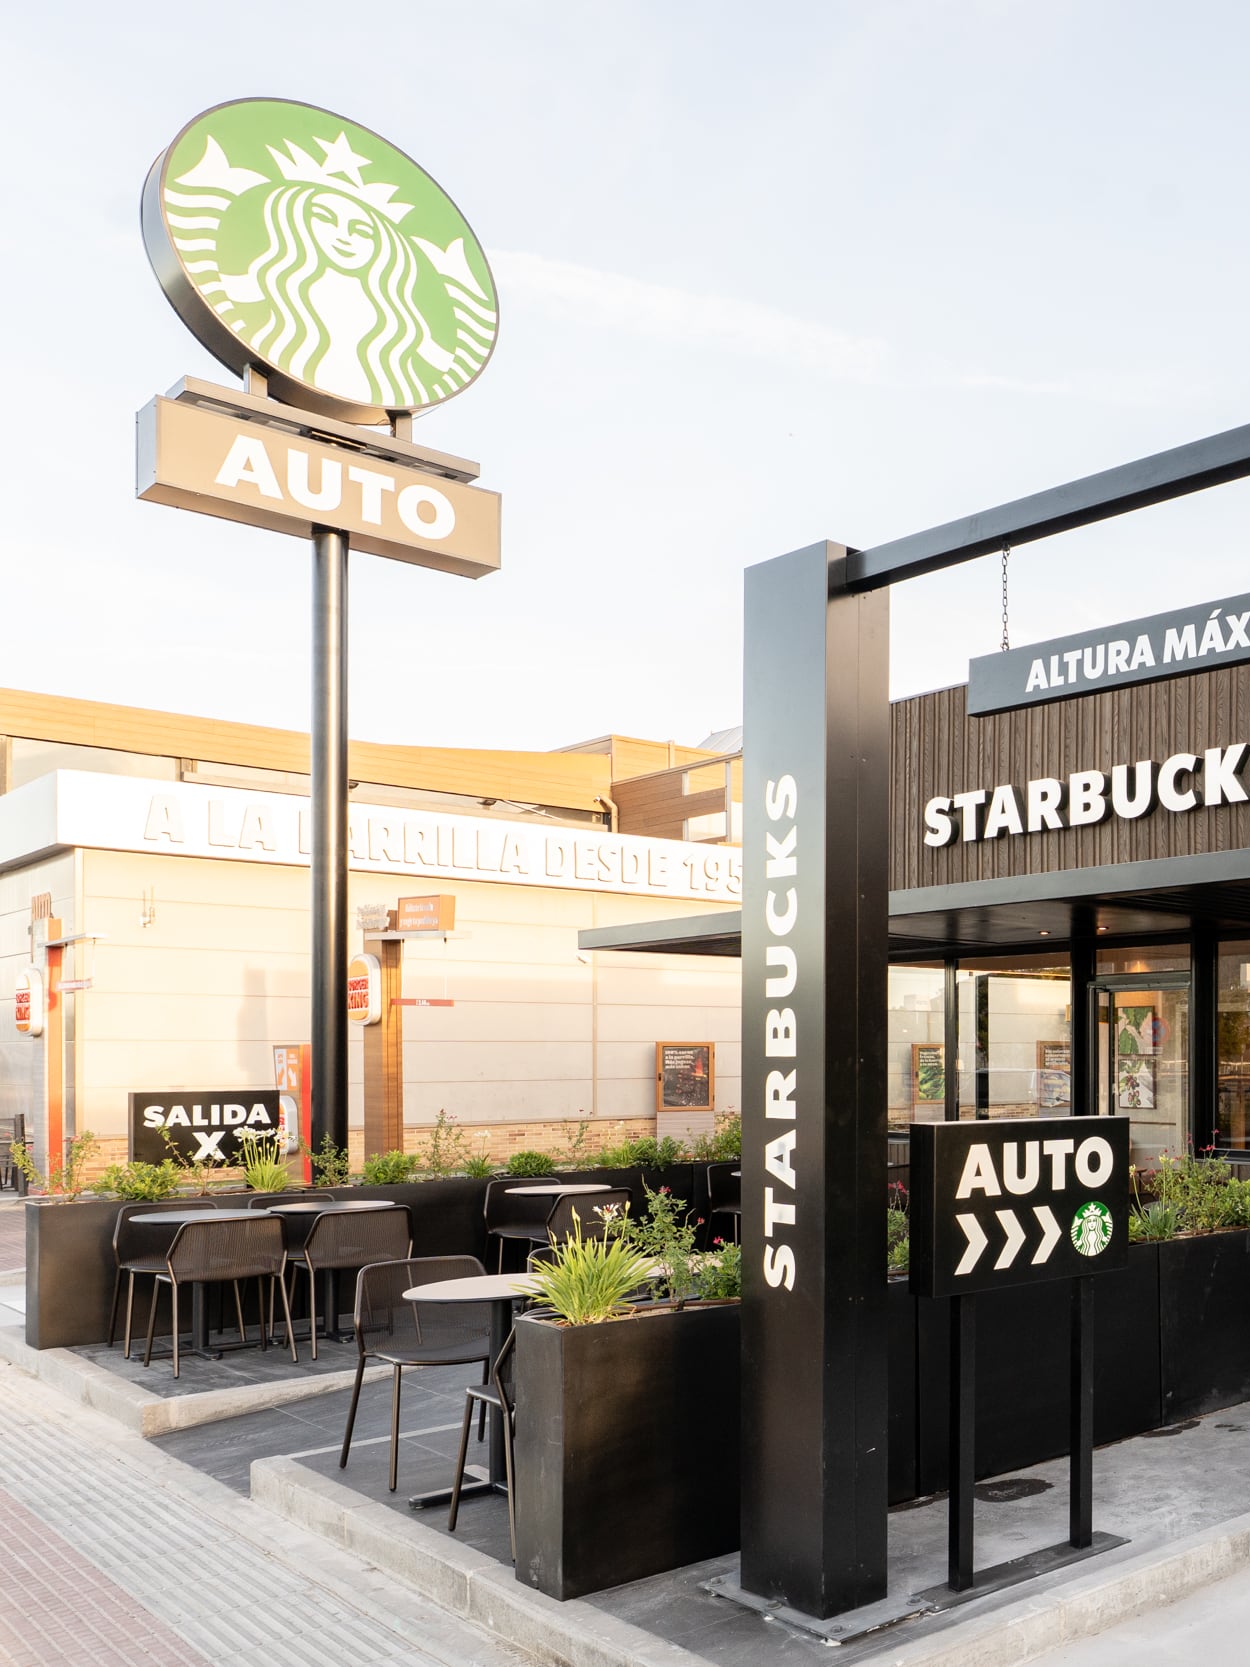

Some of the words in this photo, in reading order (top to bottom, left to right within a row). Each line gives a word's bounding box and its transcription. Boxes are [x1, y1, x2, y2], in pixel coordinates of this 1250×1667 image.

[214, 434, 456, 540] AUTO
[1025, 634, 1155, 693] ALTURA
[143, 795, 184, 842] A
[208, 799, 277, 852] LA
[545, 837, 668, 888] DESDE
[682, 852, 742, 895] 195
[764, 774, 798, 1292] STARBUCKS
[143, 1104, 271, 1127] SALIDA
[192, 1131, 226, 1161] X
[955, 1136, 1114, 1199] AUTO
